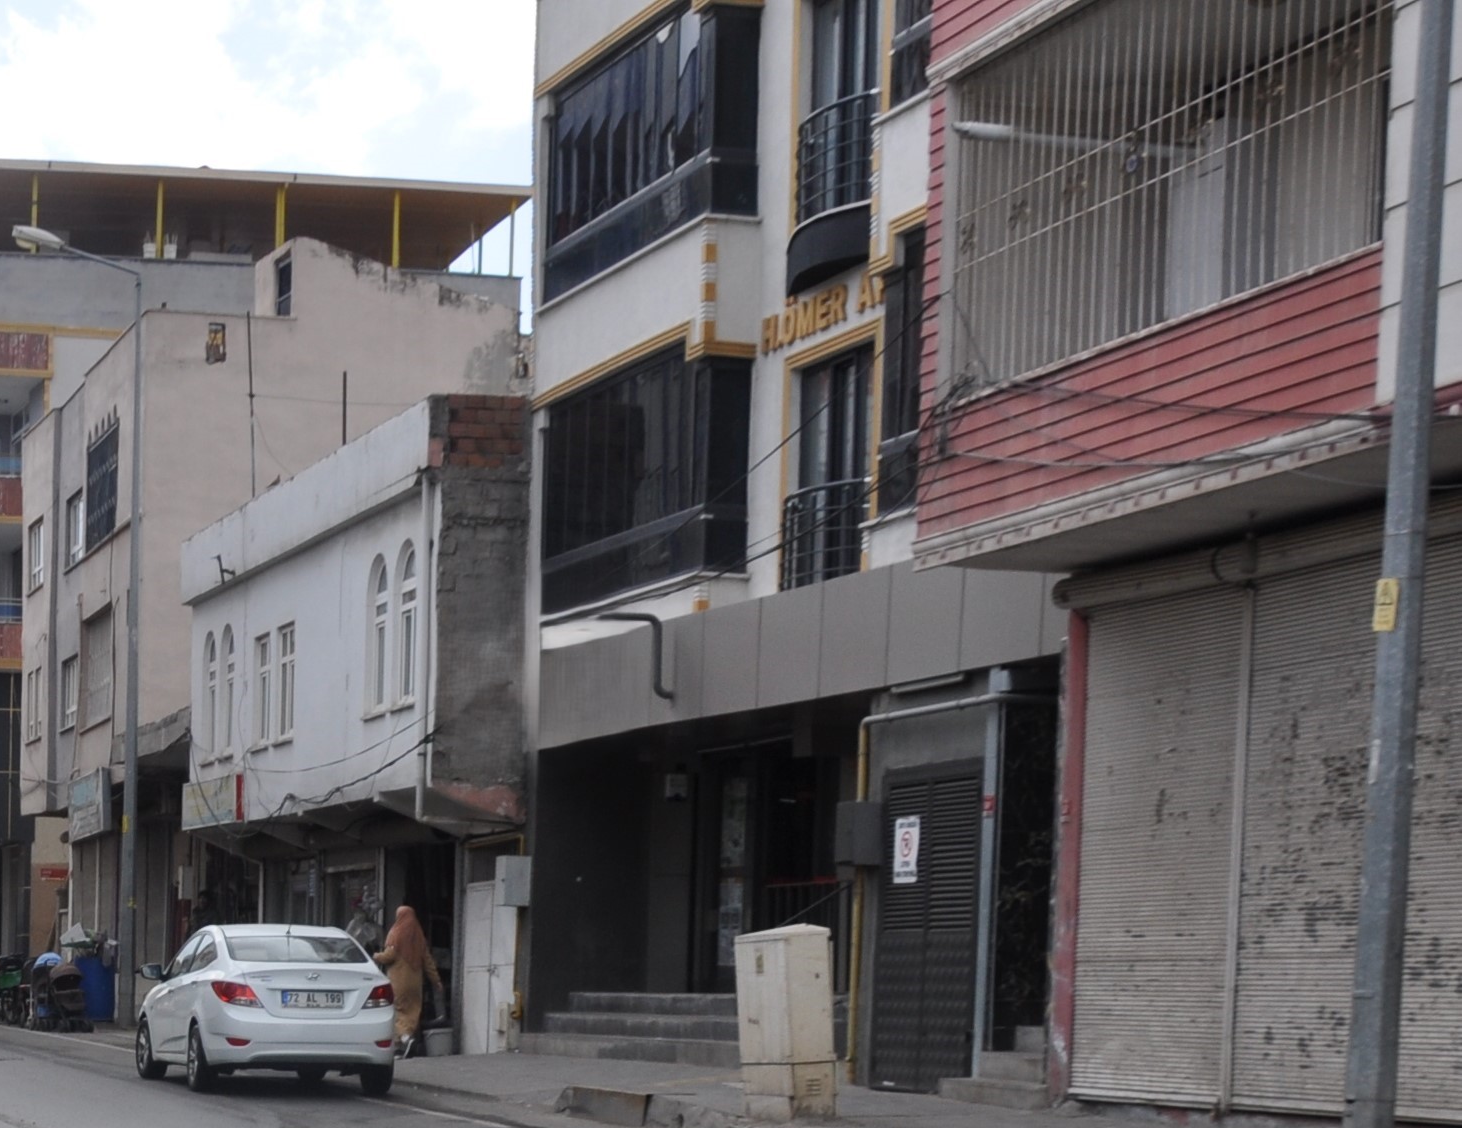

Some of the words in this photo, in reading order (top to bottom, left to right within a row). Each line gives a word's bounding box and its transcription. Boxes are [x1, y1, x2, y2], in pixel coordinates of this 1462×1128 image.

[288, 992, 299, 1003] 72
[306, 992, 317, 1003] AL
[325, 992, 341, 1004] 199
